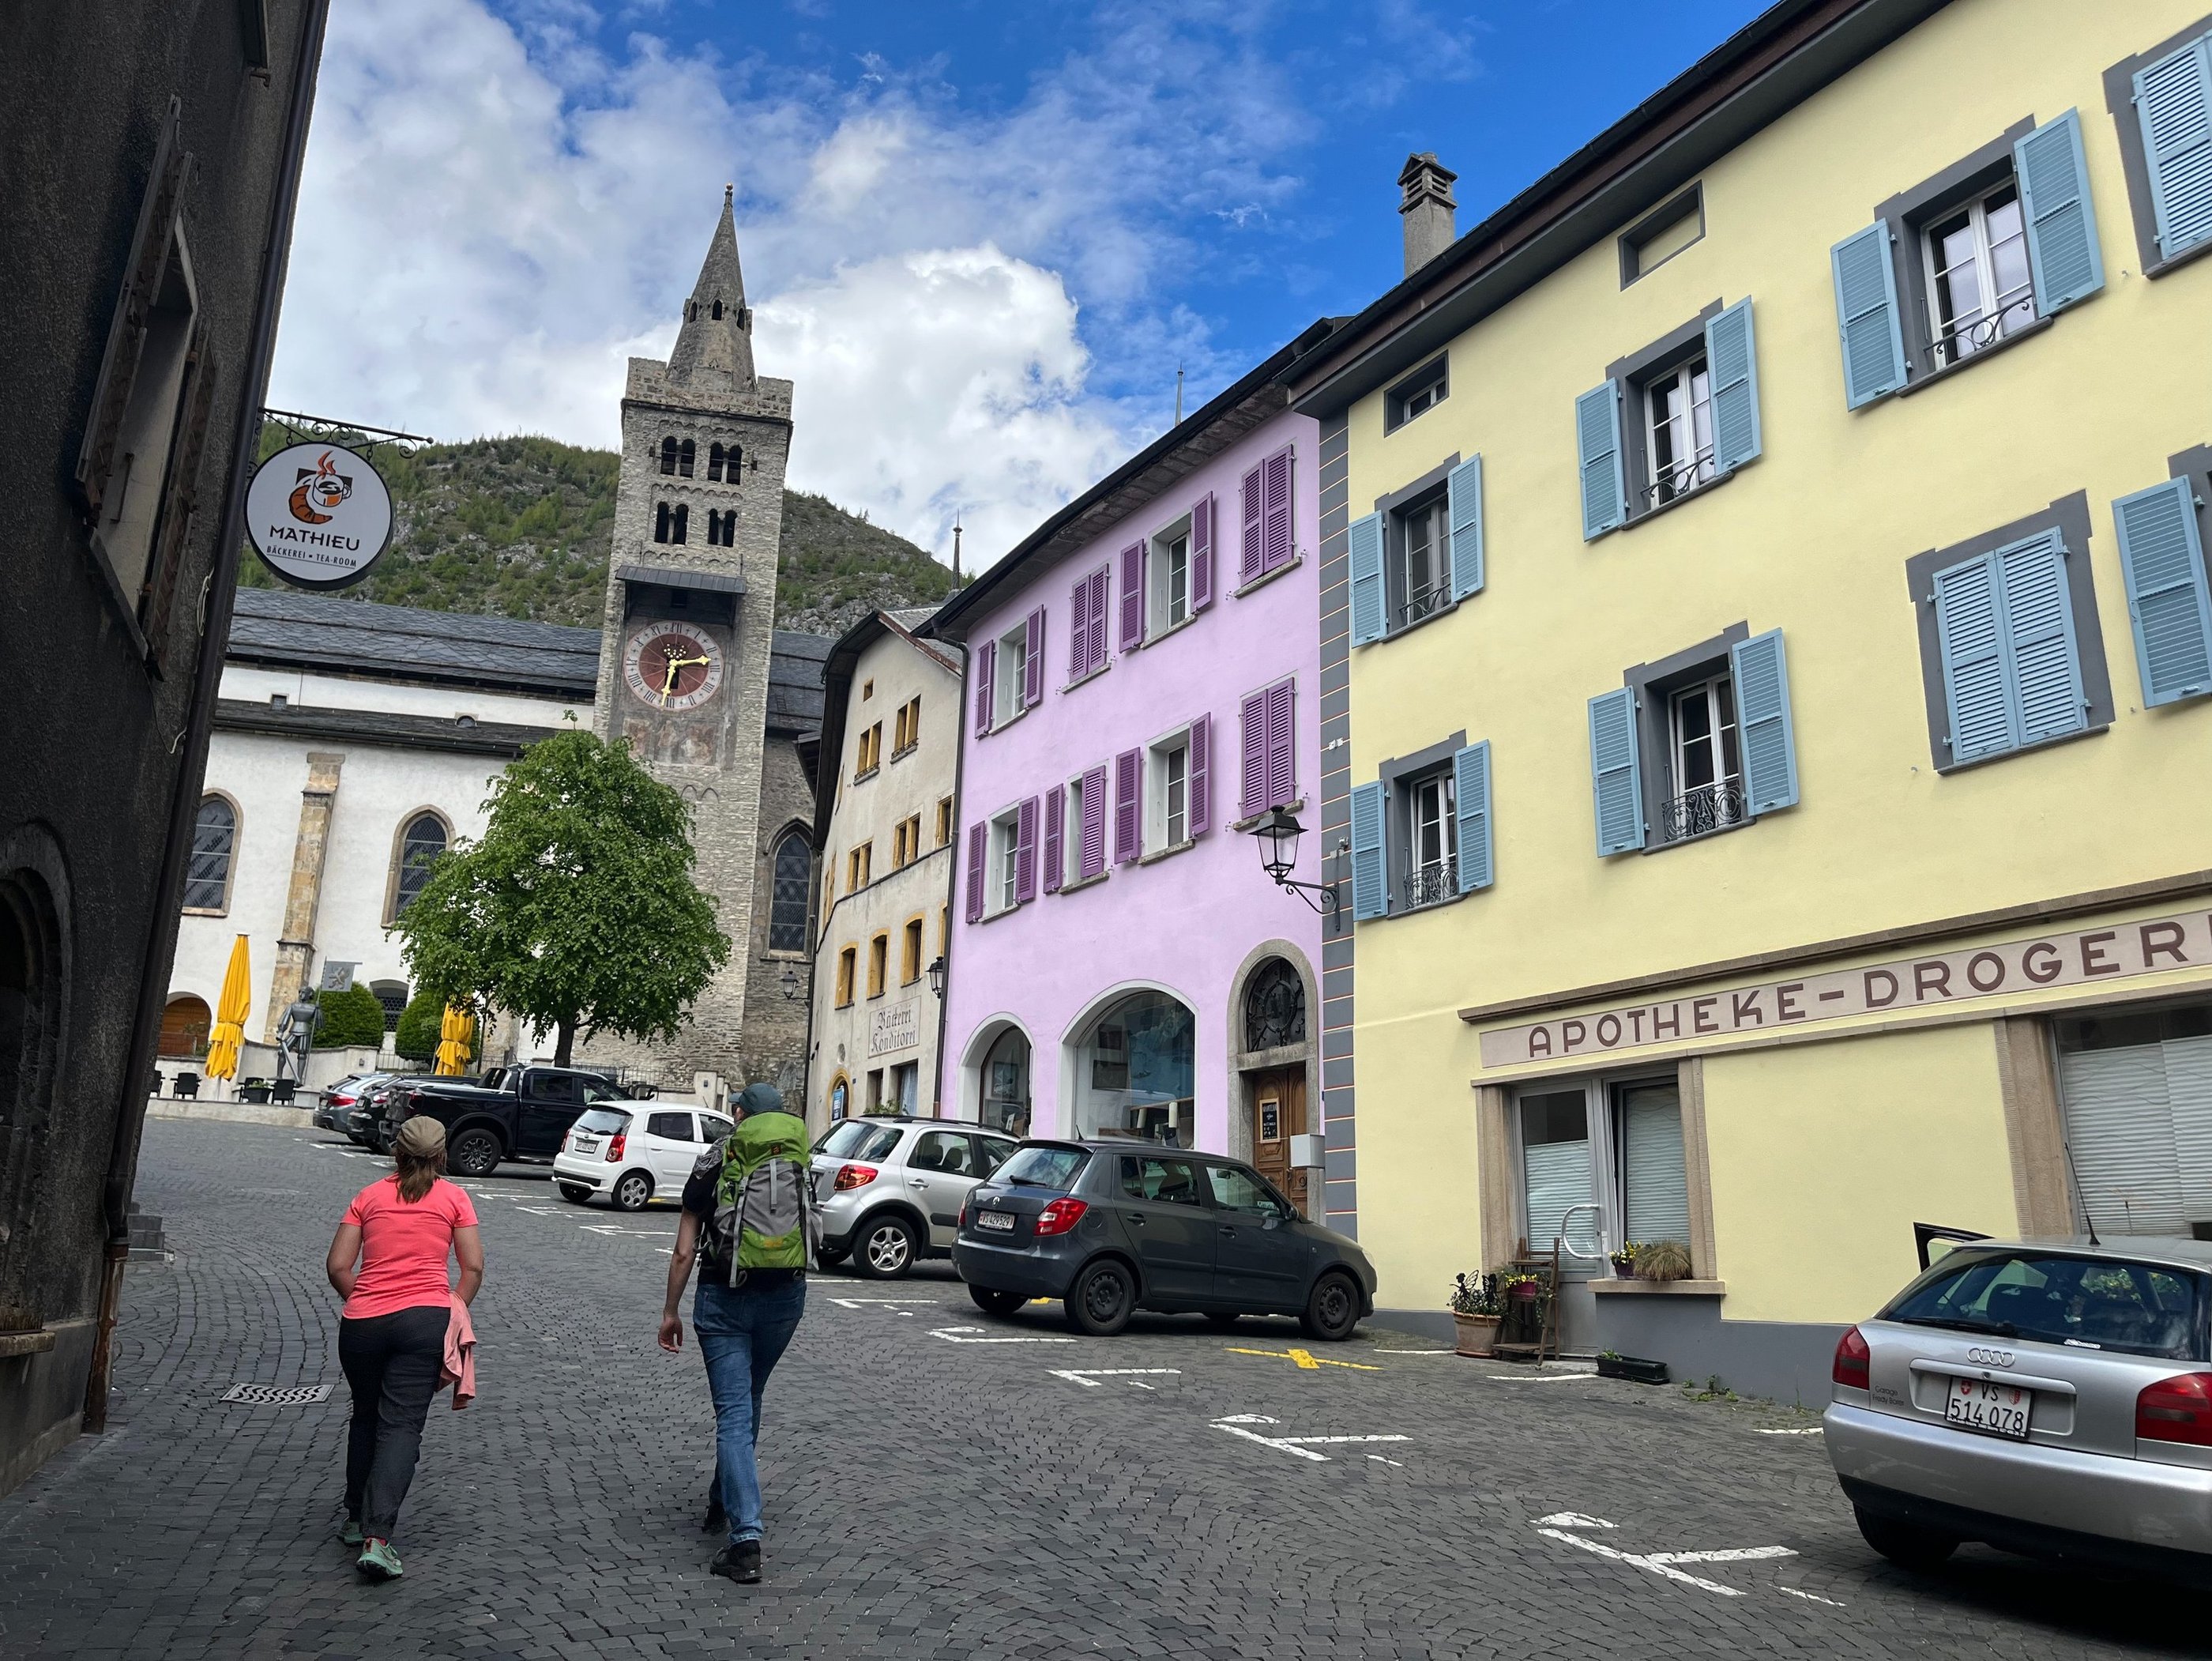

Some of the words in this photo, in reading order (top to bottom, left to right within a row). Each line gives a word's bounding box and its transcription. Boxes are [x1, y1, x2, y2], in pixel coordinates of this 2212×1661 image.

[269, 525, 360, 552] MATHIEU
[266, 544, 307, 559] BÄCKEREI
[316, 553, 357, 567] TEA-ROOM
[878, 1004, 911, 1030] Bäckerei
[871, 1025, 916, 1052] Konditorei
[1981, 1384, 1999, 1402] VS
